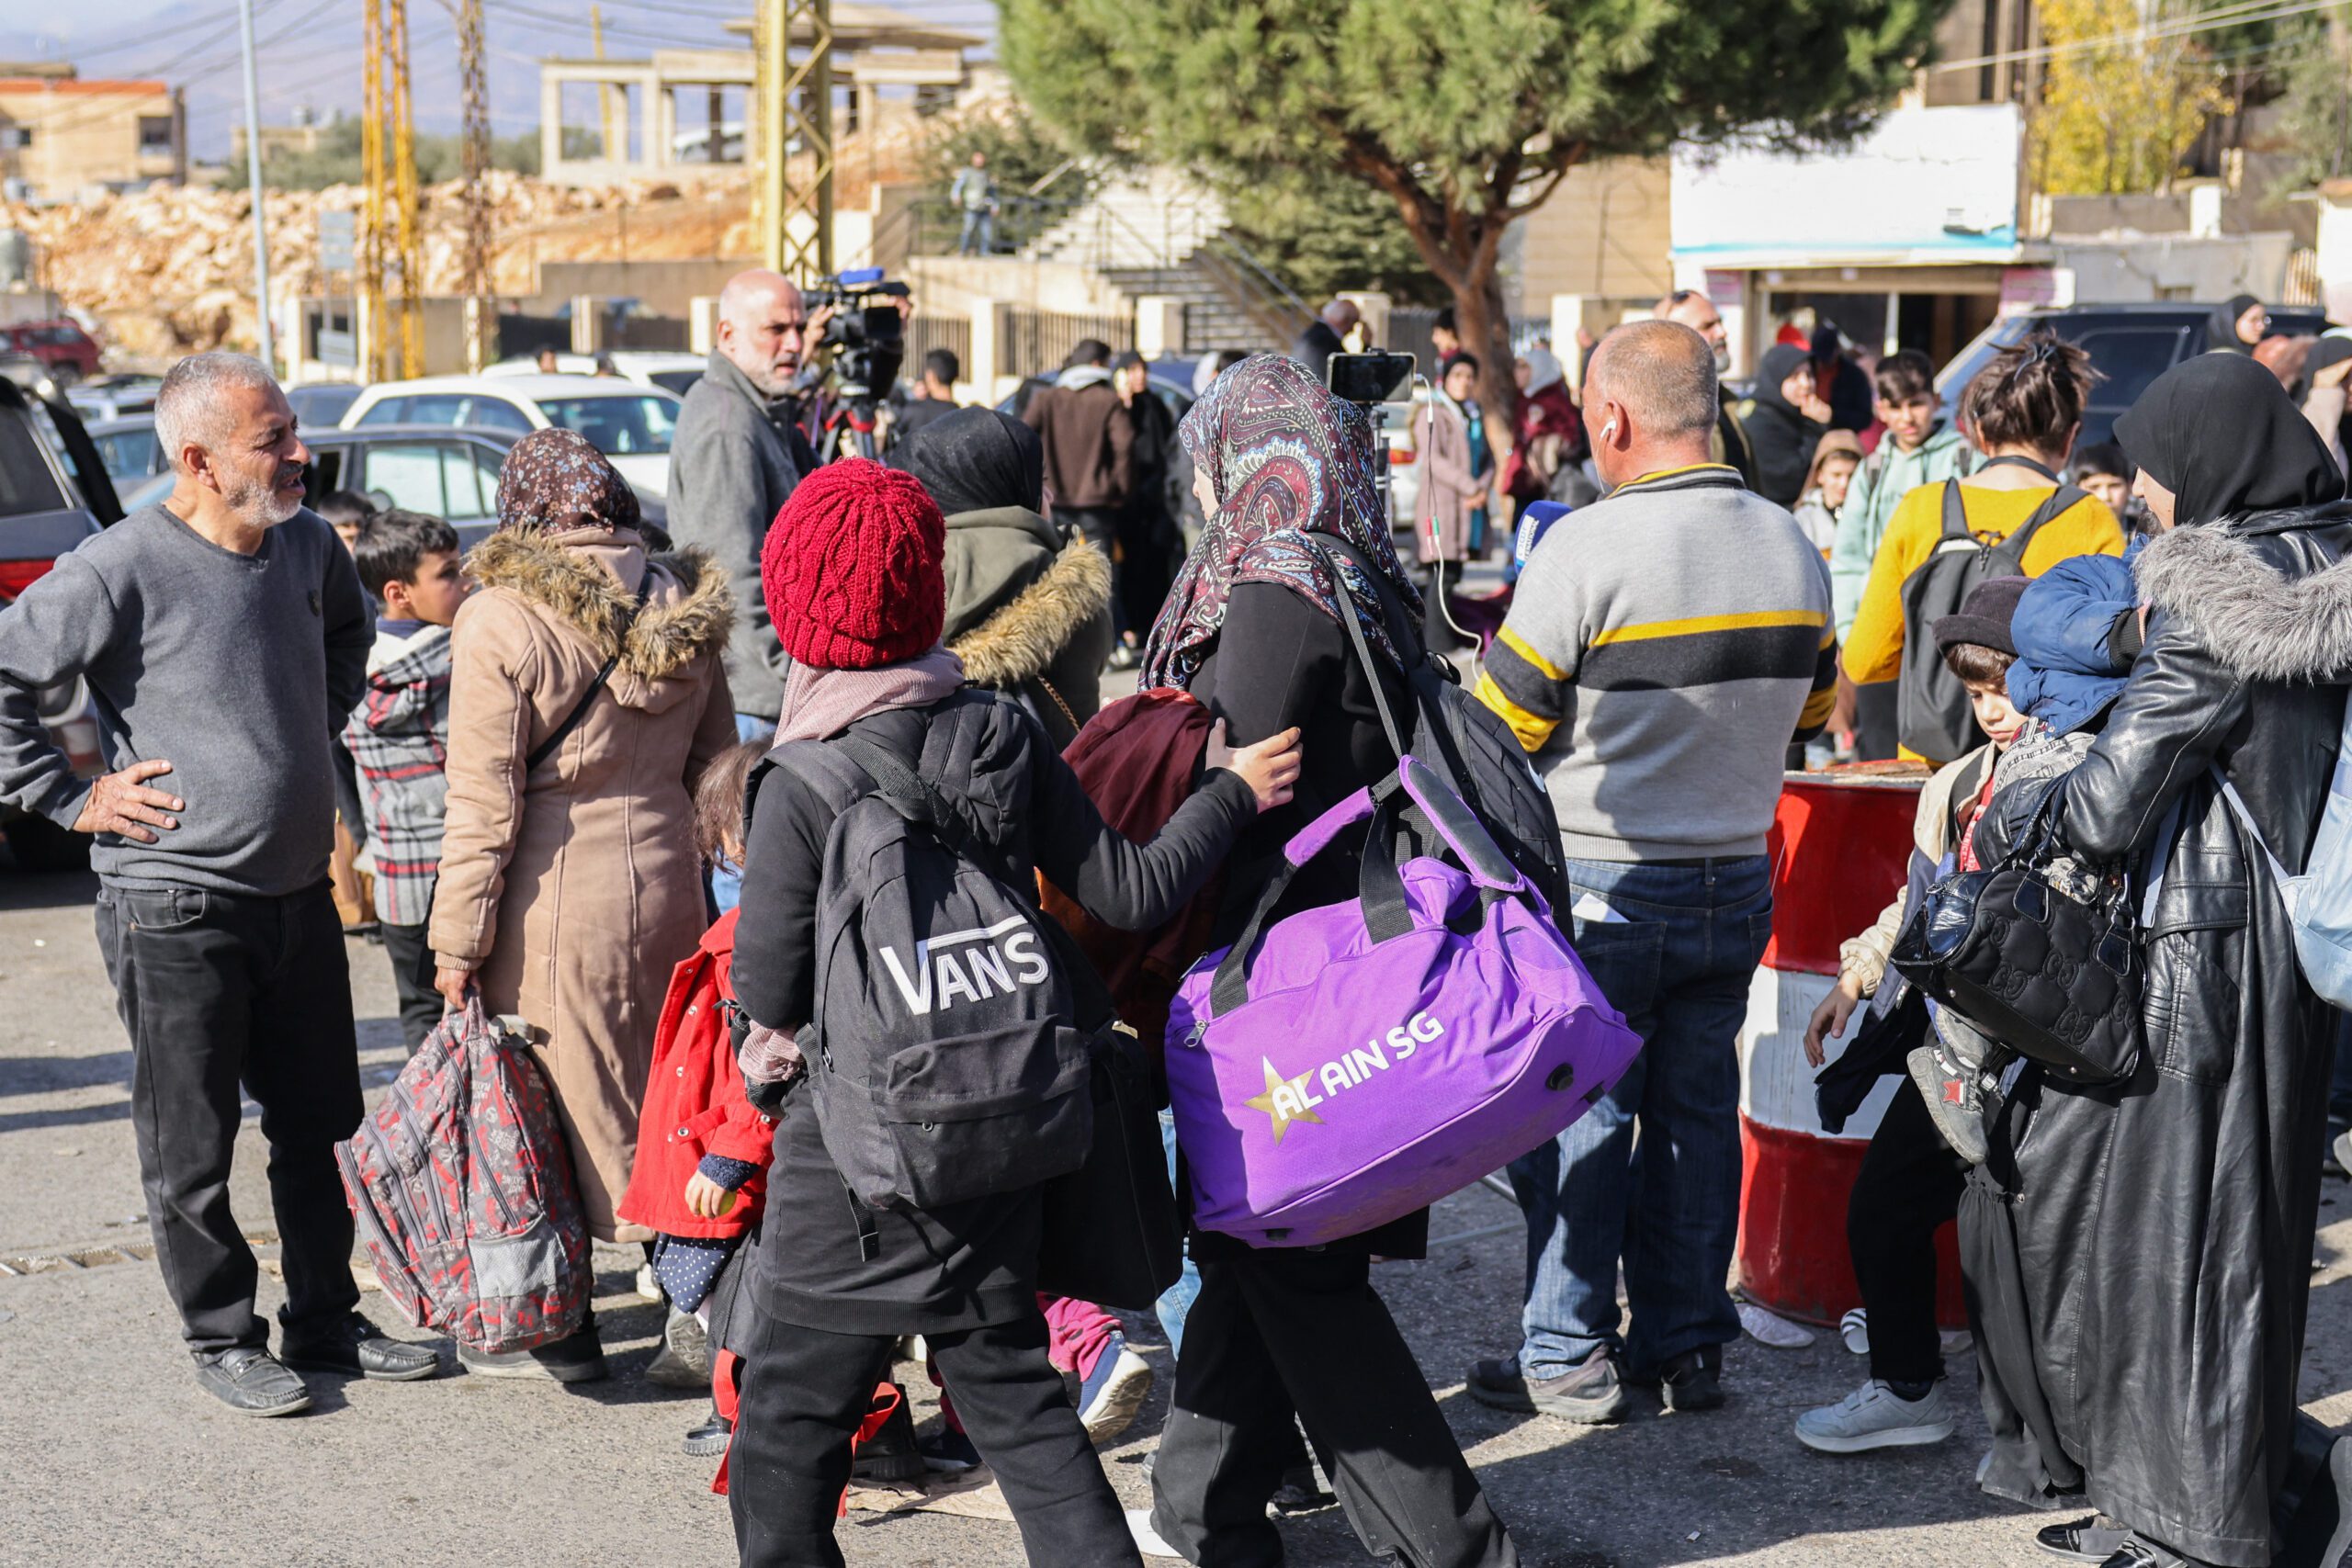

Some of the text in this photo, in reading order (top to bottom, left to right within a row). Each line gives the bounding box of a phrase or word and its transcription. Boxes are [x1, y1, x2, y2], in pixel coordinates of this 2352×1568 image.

[879, 915, 1049, 1015] VANS
[1271, 1011, 1445, 1122] AL AIN SG
